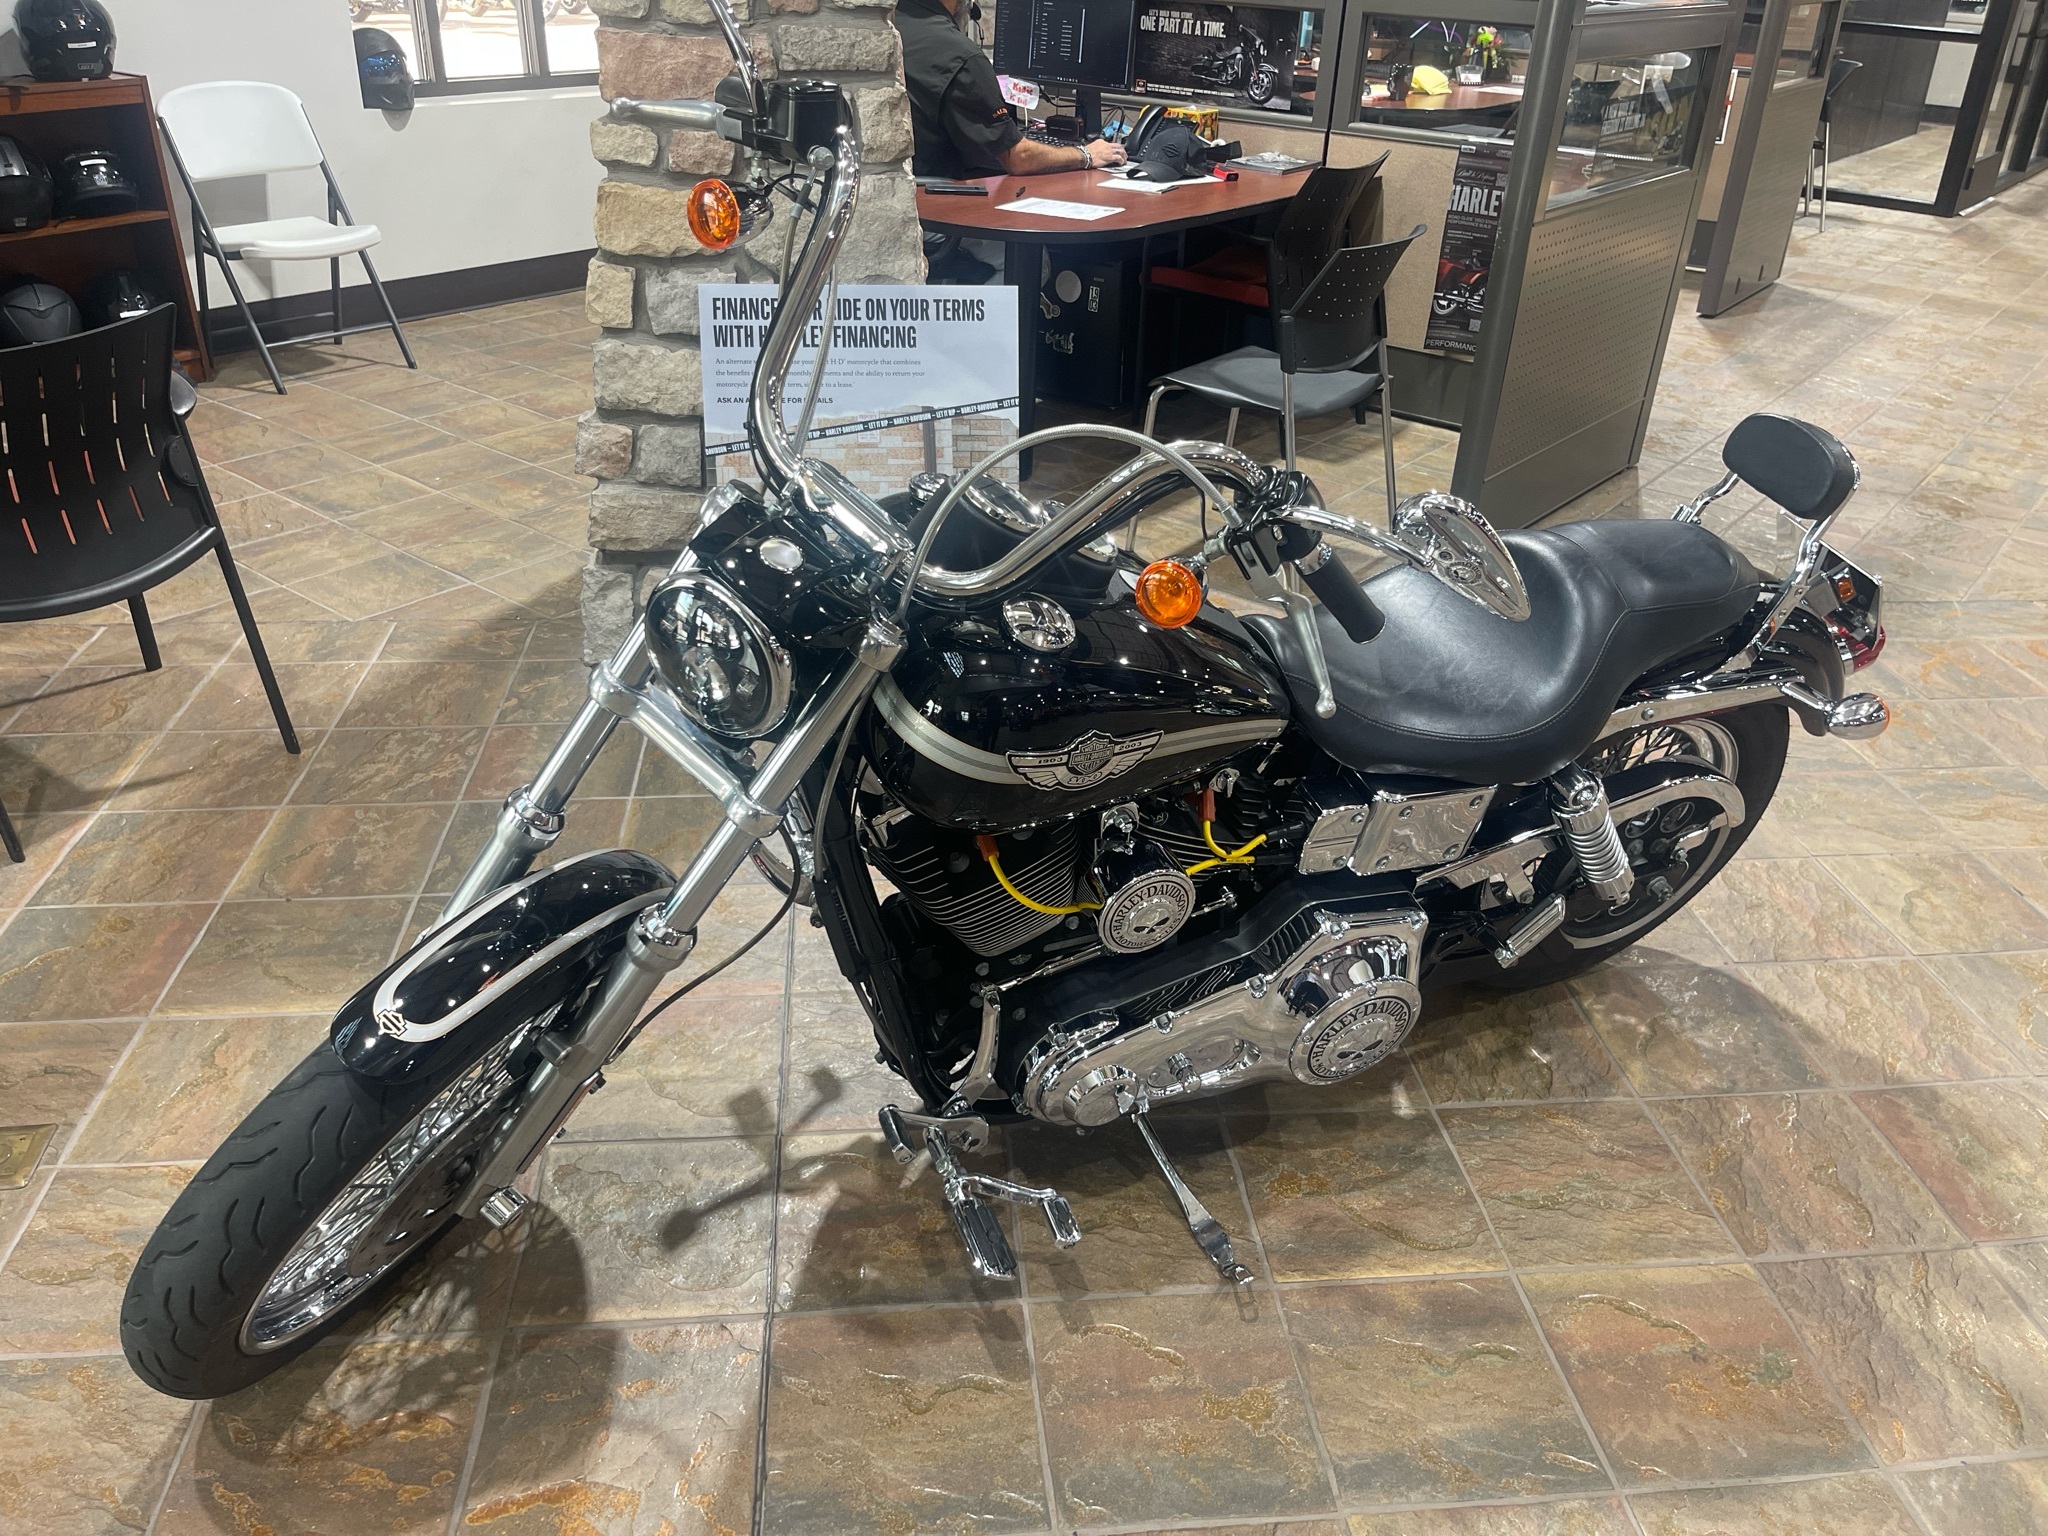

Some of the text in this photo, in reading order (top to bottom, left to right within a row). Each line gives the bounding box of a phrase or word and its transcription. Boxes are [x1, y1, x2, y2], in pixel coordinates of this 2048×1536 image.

[1140, 15, 1226, 38] ONE PART AT A TIME.
[1447, 185, 1505, 217] HARLE
[835, 298, 861, 321] IDE
[865, 298, 886, 321] ON
[890, 299, 929, 321] YOUR
[933, 299, 985, 322] TERMS
[713, 325, 754, 348] WITH
[833, 325, 917, 348] FINANCING
[1425, 339, 1477, 352] PERFORMANC
[847, 359, 879, 368] motorcycle
[866, 371, 884, 379] ability
[716, 381, 748, 389] motorcycle
[1038, 756, 1063, 764] 1903
[1119, 741, 1142, 751] 2003
[1113, 884, 1186, 933] HARLEY-DAVIDSON
[1312, 1000, 1407, 1058] HARLEY-DAVIDSON
